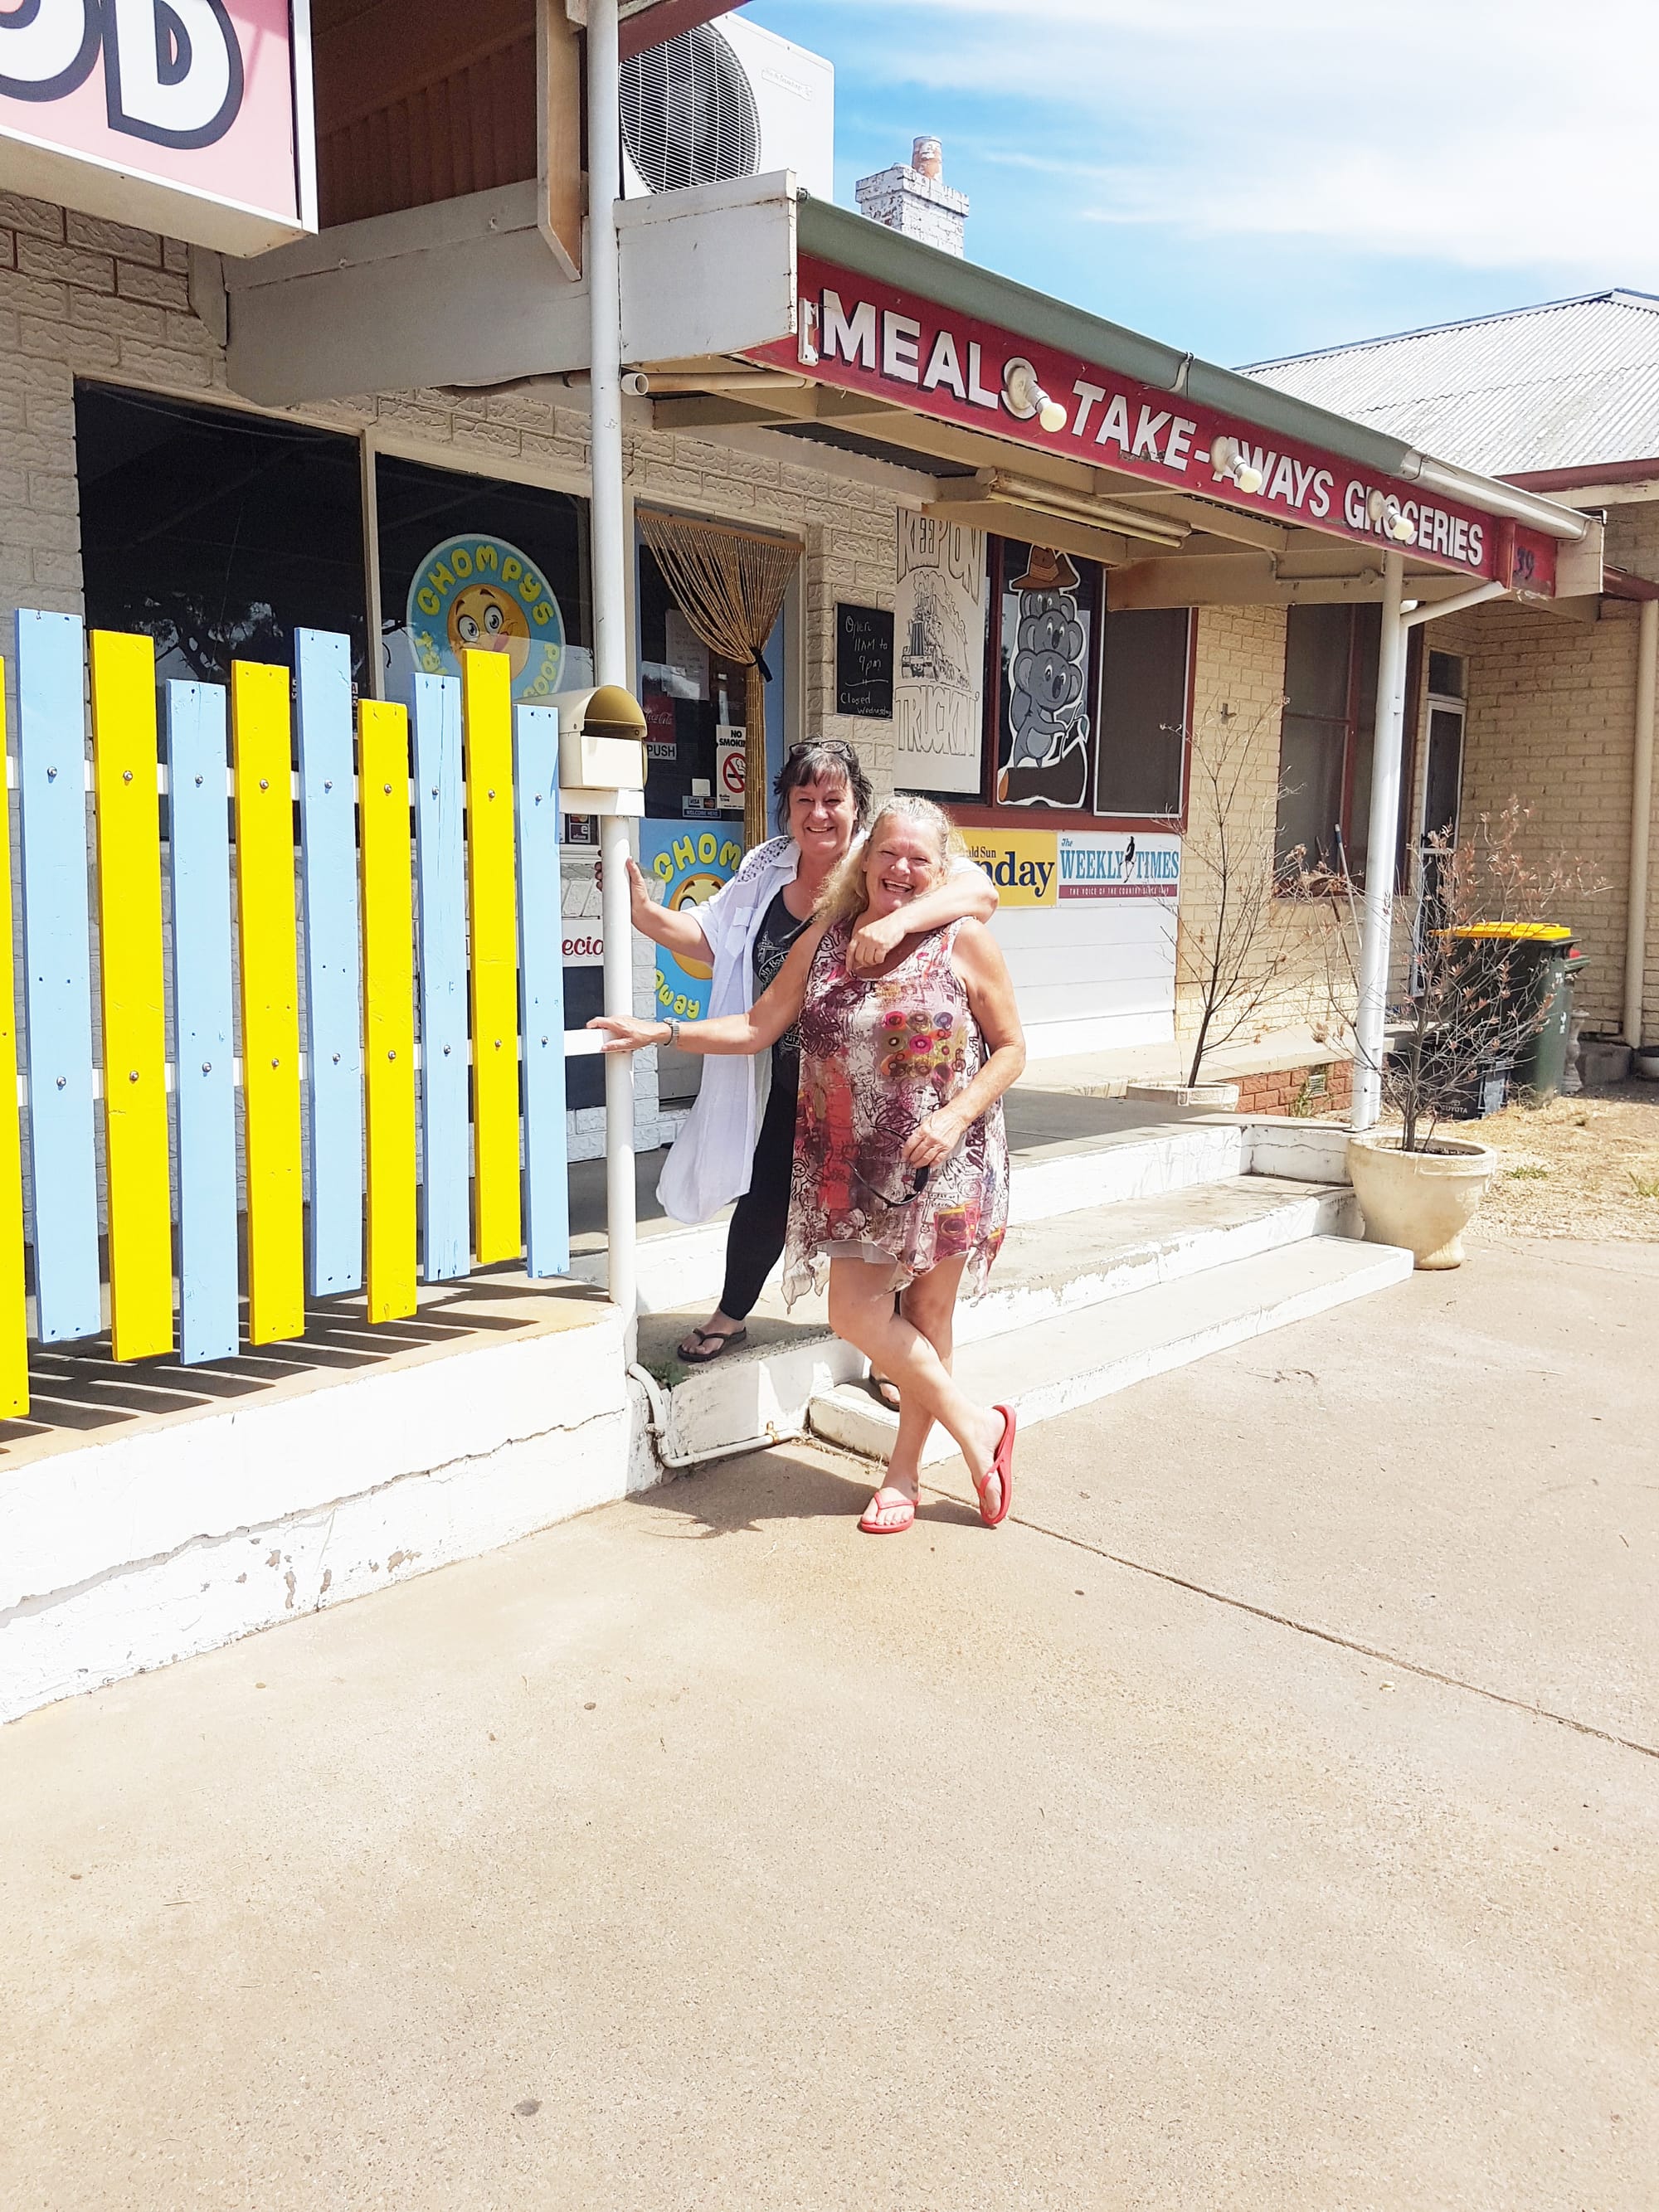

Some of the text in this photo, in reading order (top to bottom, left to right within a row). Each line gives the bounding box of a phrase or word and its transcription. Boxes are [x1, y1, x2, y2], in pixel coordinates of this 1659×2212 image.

[896, 505, 948, 584] KEEP
[417, 544, 555, 626] CHOMPYS
[879, 638, 888, 650] to
[859, 655, 882, 676] 9pm
[840, 691, 871, 705] Closed
[730, 730, 742, 738] NO
[647, 744, 675, 757] PUSH
[1061, 838, 1073, 848] The
[980, 846, 996, 858] Sun
[1059, 849, 1180, 879] WEEKLY TIMES
[1107, 887, 1117, 896] THE
